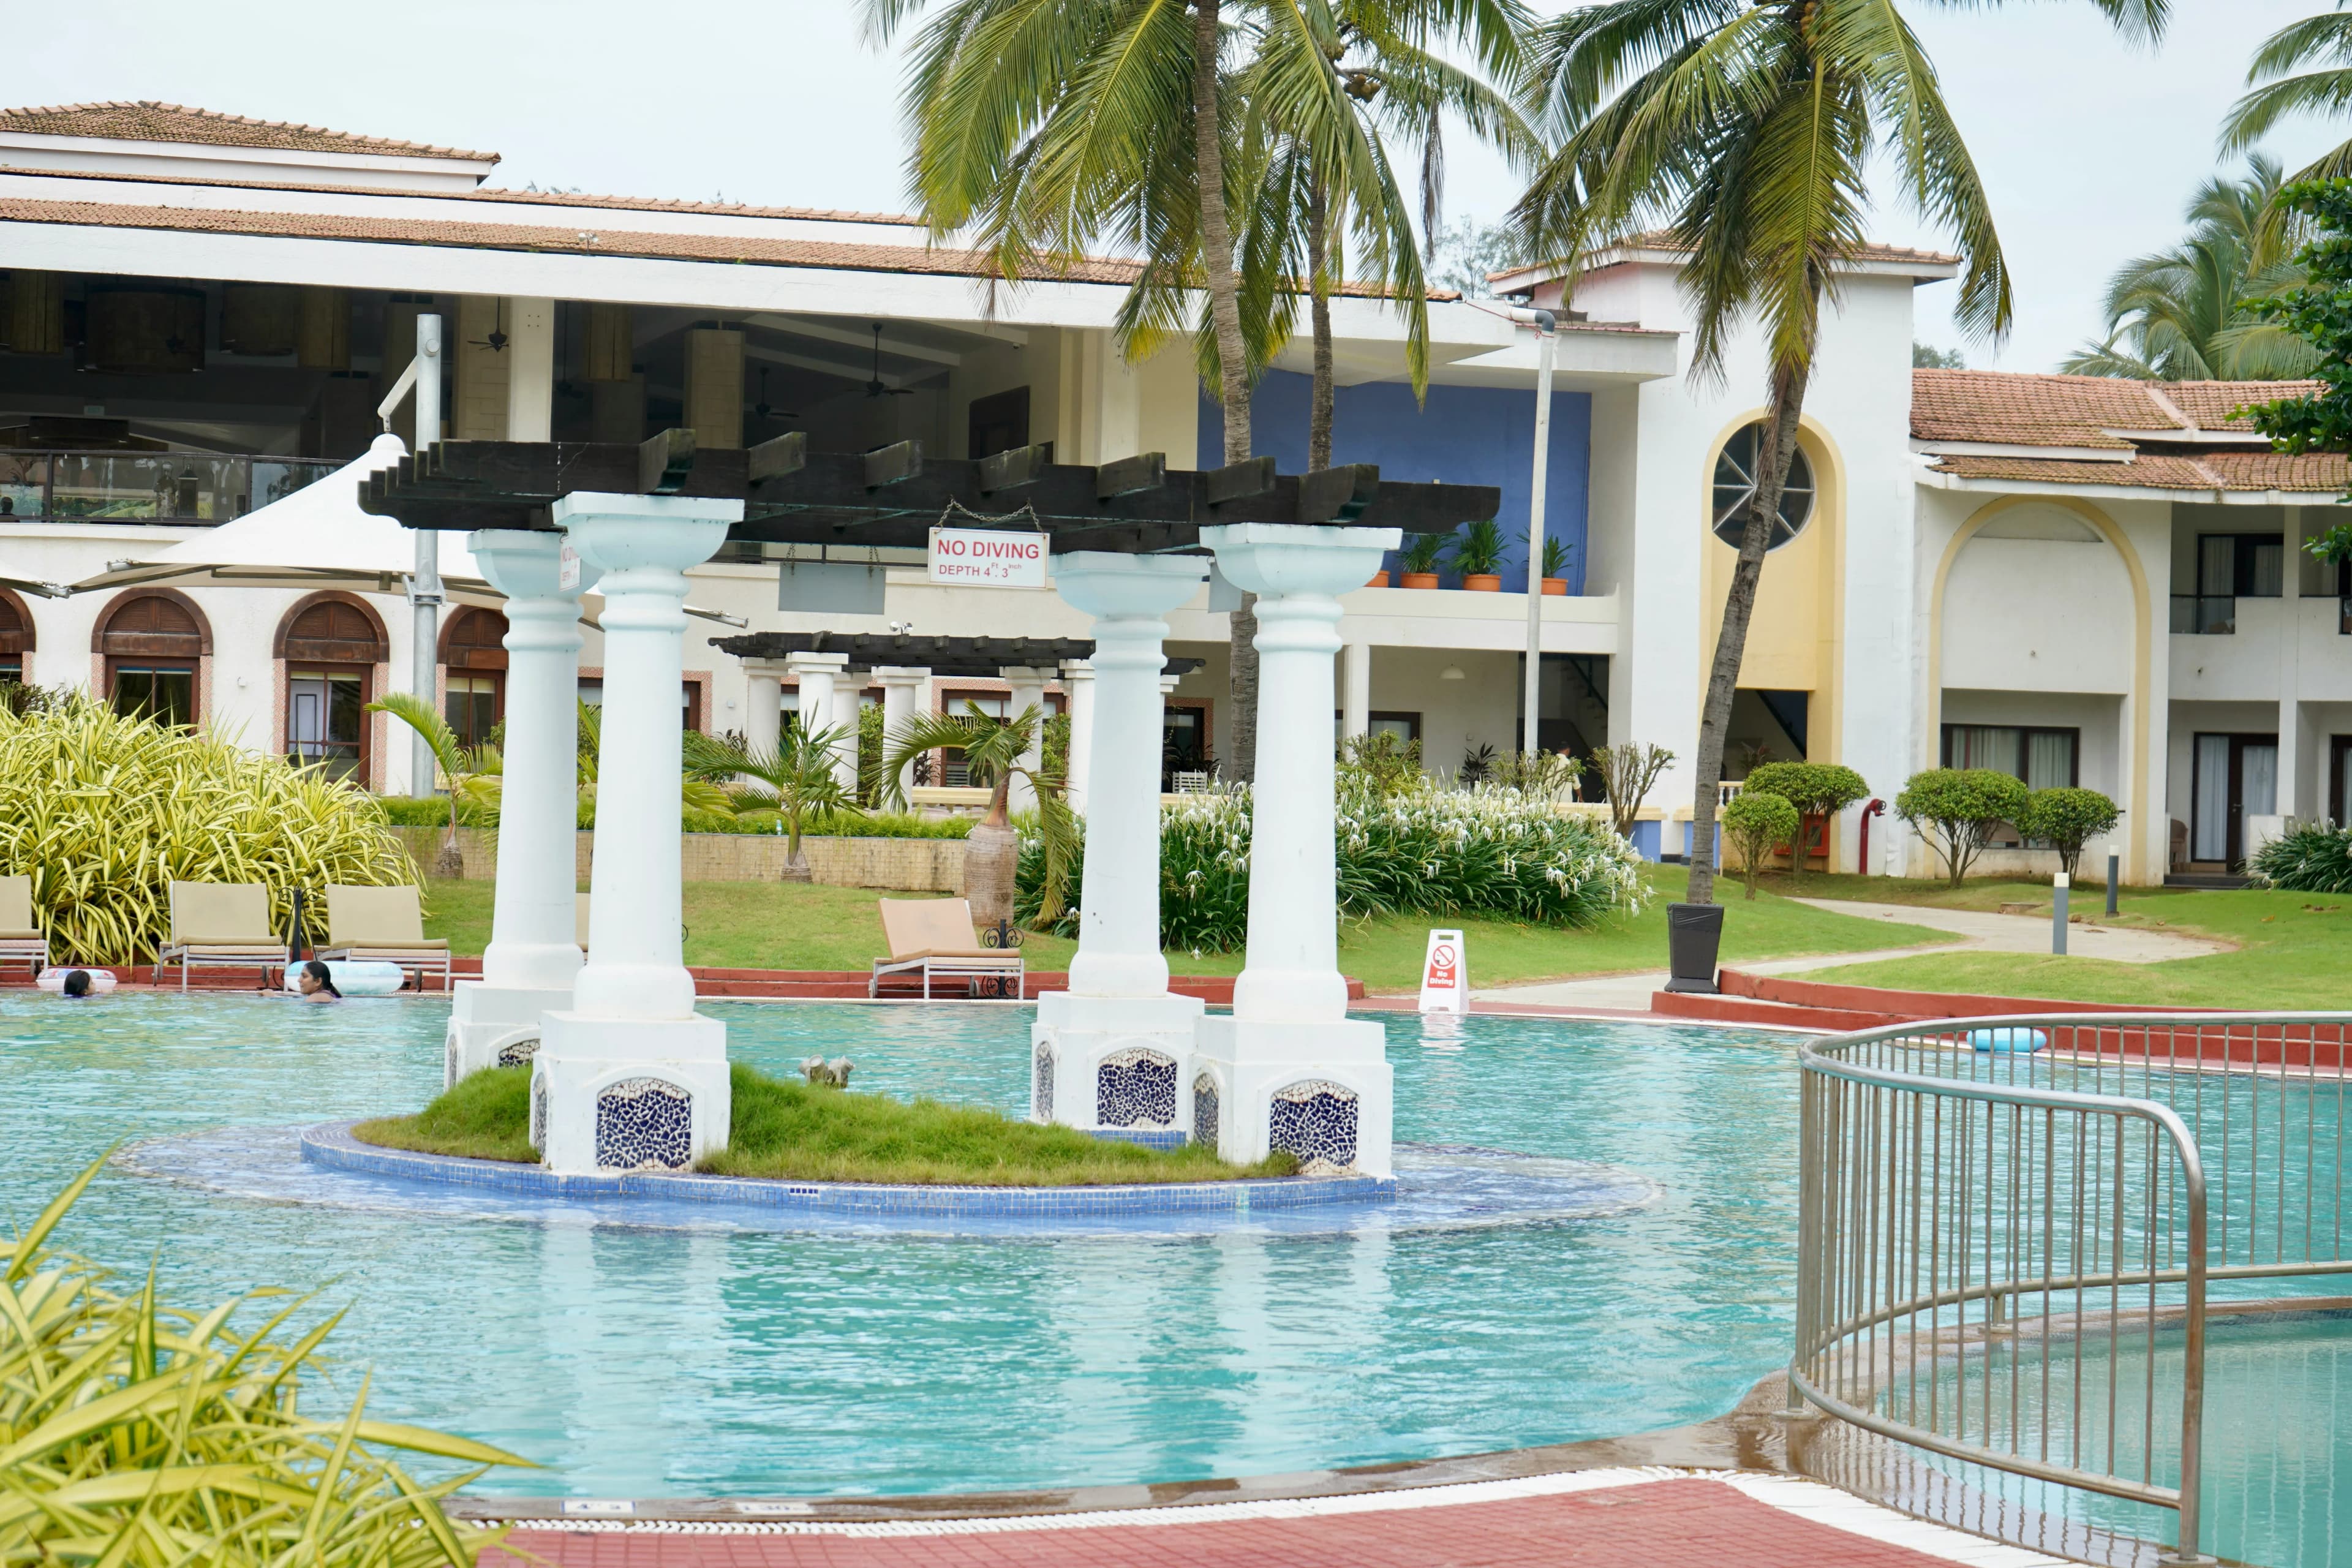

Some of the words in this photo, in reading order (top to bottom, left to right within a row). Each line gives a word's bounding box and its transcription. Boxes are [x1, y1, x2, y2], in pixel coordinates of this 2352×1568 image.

[938, 539, 965, 556] NO
[973, 541, 1039, 559] DIVING
[939, 565, 979, 576] DEPTH
